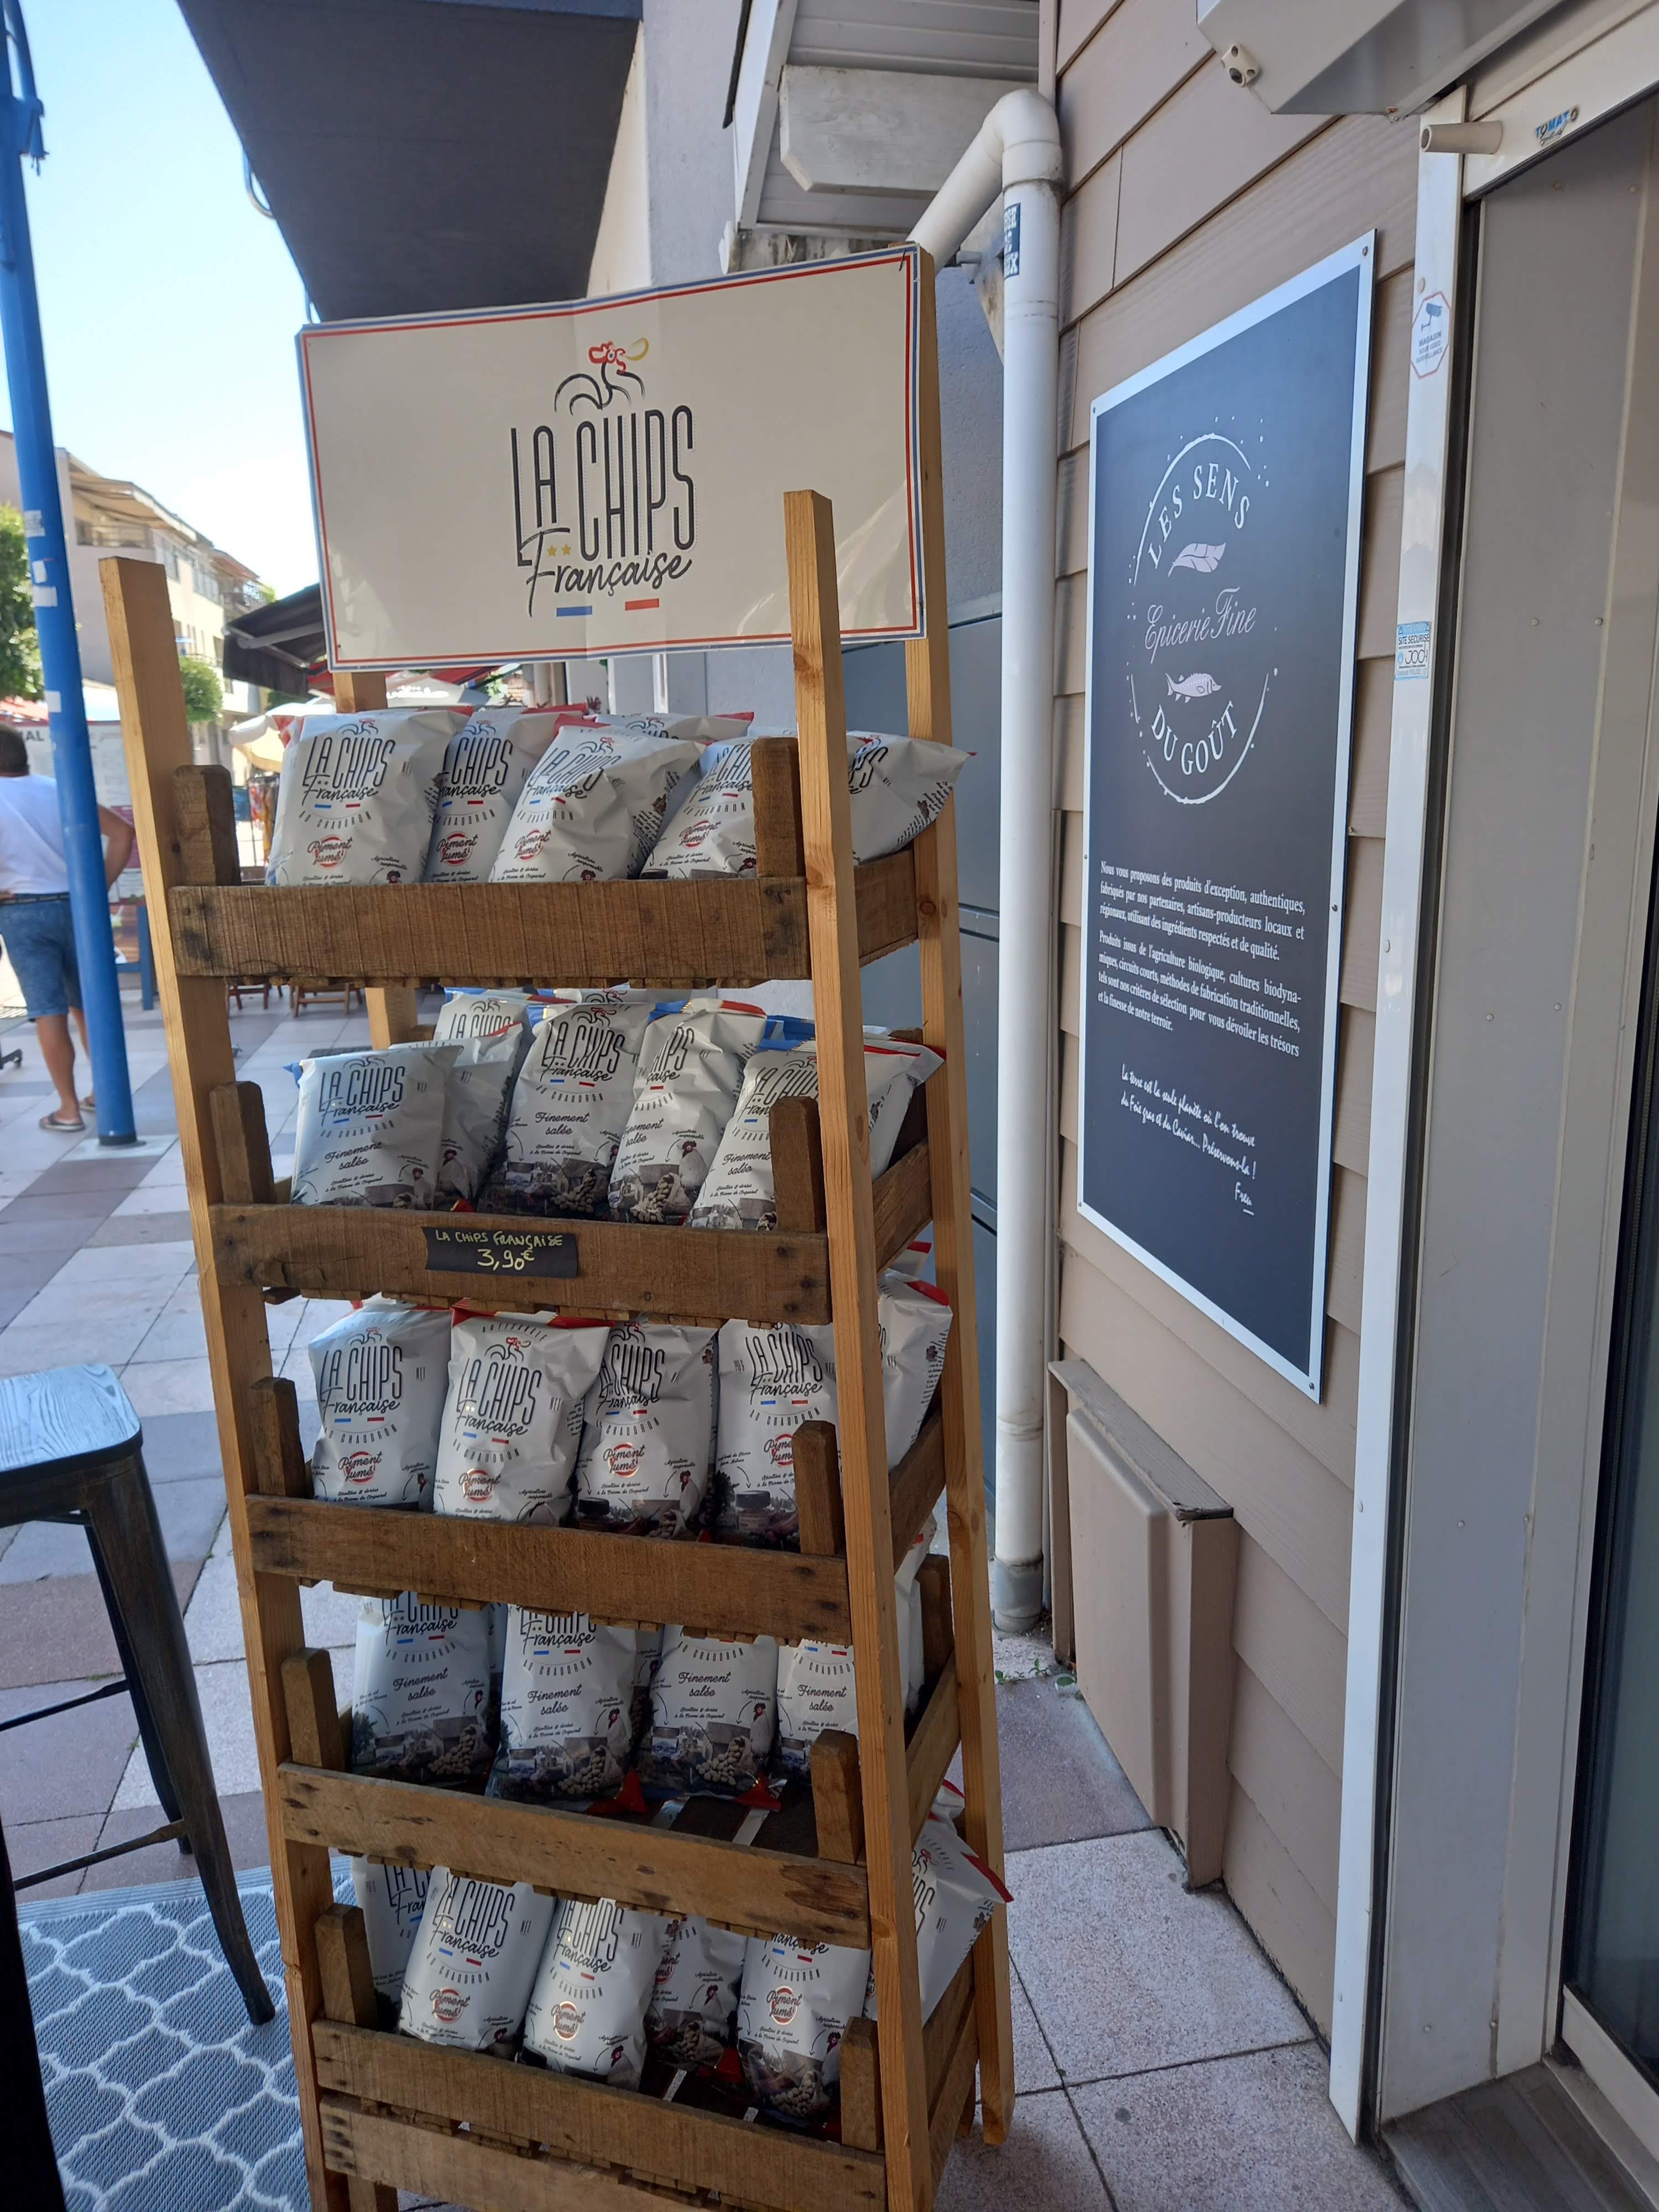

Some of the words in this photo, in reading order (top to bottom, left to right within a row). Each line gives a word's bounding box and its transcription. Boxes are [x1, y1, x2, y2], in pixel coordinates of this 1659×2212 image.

[1536, 108, 1579, 139] TOMATO
[510, 425, 557, 568] LA
[576, 404, 697, 562] CHIPS
[1193, 463, 1250, 529] SENS
[517, 526, 693, 618] Française
[1145, 604, 1211, 664] Epicerie
[1210, 587, 1256, 639] Fine
[1399, 636, 1407, 645] SITE
[1151, 704, 1178, 761] DU
[1181, 701, 1238, 775] GOÛT
[302, 736, 333, 786] LA
[332, 738, 395, 789] CHIPS
[451, 737, 513, 786] CHIPS
[301, 775, 379, 806] Française
[307, 837, 353, 853] Piment
[437, 835, 478, 851] Piment
[1101, 861, 1114, 875] Nous
[1116, 867, 1128, 878] vous
[1130, 870, 1160, 885] proposons
[1162, 872, 1172, 886] des
[1174, 876, 1201, 893] produits
[1204, 880, 1247, 904] d'exception,
[1250, 890, 1305, 915] authentiques,
[1100, 881, 1124, 900] fabriqués
[1126, 890, 1135, 903] par
[1137, 893, 1147, 904] nos
[1149, 896, 1185, 915] partenaires,
[1187, 900, 1261, 931] artisans-producteurs
[1265, 916, 1292, 937] locaux
[1296, 926, 1305, 940] et
[1100, 902, 1126, 922] régionaux,
[1128, 909, 1150, 926] utilisant
[1151, 915, 1161, 929] des
[1162, 917, 1197, 936] ingrédients
[1198, 930, 1229, 948] respectés
[1231, 938, 1238, 950] et
[1240, 937, 1249, 952] de
[1250, 942, 1279, 961] qualité.
[1099, 930, 1121, 948] Produits
[1124, 937, 1136, 953] issus
[1139, 942, 1146, 956] de
[1149, 944, 1185, 968] l'agriculture
[1188, 956, 1225, 983] biologique,
[1229, 971, 1260, 992] cultures
[1264, 979, 1301, 1004] biodyna-
[1099, 951, 1118, 970] miques,
[1119, 958, 1139, 975] circuits
[1140, 967, 1159, 984] courts,
[1160, 973, 1190, 993] méthodes
[1191, 981, 1198, 995] de
[1200, 983, 1238, 1010] fabrication
[1240, 999, 1300, 1034] traditionnelles,
[1098, 992, 1103, 1002] et
[1104, 992, 1109, 1005] la
[1109, 994, 1126, 1012] finesse
[1128, 1001, 1134, 1015] de
[1135, 1008, 1150, 1021] notre
[1151, 1012, 1172, 1031] terroir.
[1098, 971, 1107, 984] tels
[1108, 977, 1119, 988] sont
[1120, 981, 1129, 992] nos
[1130, 983, 1151, 1001] critères
[1152, 989, 1159, 1003] de
[1160, 993, 1187, 1014] sélection
[1190, 1007, 1206, 1020] pour
[1208, 1013, 1225, 1029] vous
[1226, 1016, 1256, 1041] dévoiler
[1258, 1027, 1269, 1045] les
[1271, 1035, 1299, 1057] trésors
[541, 1021, 568, 1067] LA
[568, 1025, 625, 1073] CHIPS
[540, 1056, 612, 1083] Française
[319, 1071, 341, 1112] LA
[346, 1066, 405, 1106] CHIPS
[321, 1097, 400, 1126] Française
[535, 1112, 589, 1124] Finement
[1178, 1094, 1201, 1119] planète
[545, 1125, 573, 1135] salée
[625, 1134, 648, 1147] salée
[325, 1141, 383, 1164] Finement
[338, 1156, 369, 1170] salée
[722, 1151, 772, 1165] Finement
[727, 1165, 753, 1176] salée
[435, 1230, 450, 1242] LA
[477, 1249, 535, 1270] 3,90€
[320, 1349, 342, 1402] LA
[347, 1345, 403, 1401] CHIPS
[611, 1344, 665, 1399] CHIPS
[745, 1336, 768, 1386] LA
[767, 1332, 823, 1383] CHIPS
[322, 1386, 401, 1422] Française
[456, 1358, 481, 1412] LA
[478, 1362, 542, 1426] CHIPS
[750, 1372, 822, 1406] Française
[455, 1399, 529, 1437] Française
[338, 1451, 383, 1469] Piment
[603, 1443, 645, 1461] Piment
[458, 1471, 501, 1487] Piment
[384, 1611, 457, 1646] Française
[521, 1620, 596, 1655] Française
[393, 1667, 448, 1691] Finement
[678, 1671, 732, 1684] Finement
[689, 1686, 716, 1697] salée
[798, 1684, 848, 1698] Finement
[408, 1687, 436, 1702] salée
[527, 1684, 582, 1704] Finement
[540, 1703, 569, 1716] salée
[809, 1701, 834, 1713] salée
[455, 1880, 515, 1948] CHIPS
[430, 1914, 499, 1958] Française
[552, 1927, 612, 1973] Française
[430, 1989, 471, 2007] Piment
[766, 1991, 802, 2007] Piment
[551, 2004, 586, 2024] Piment
